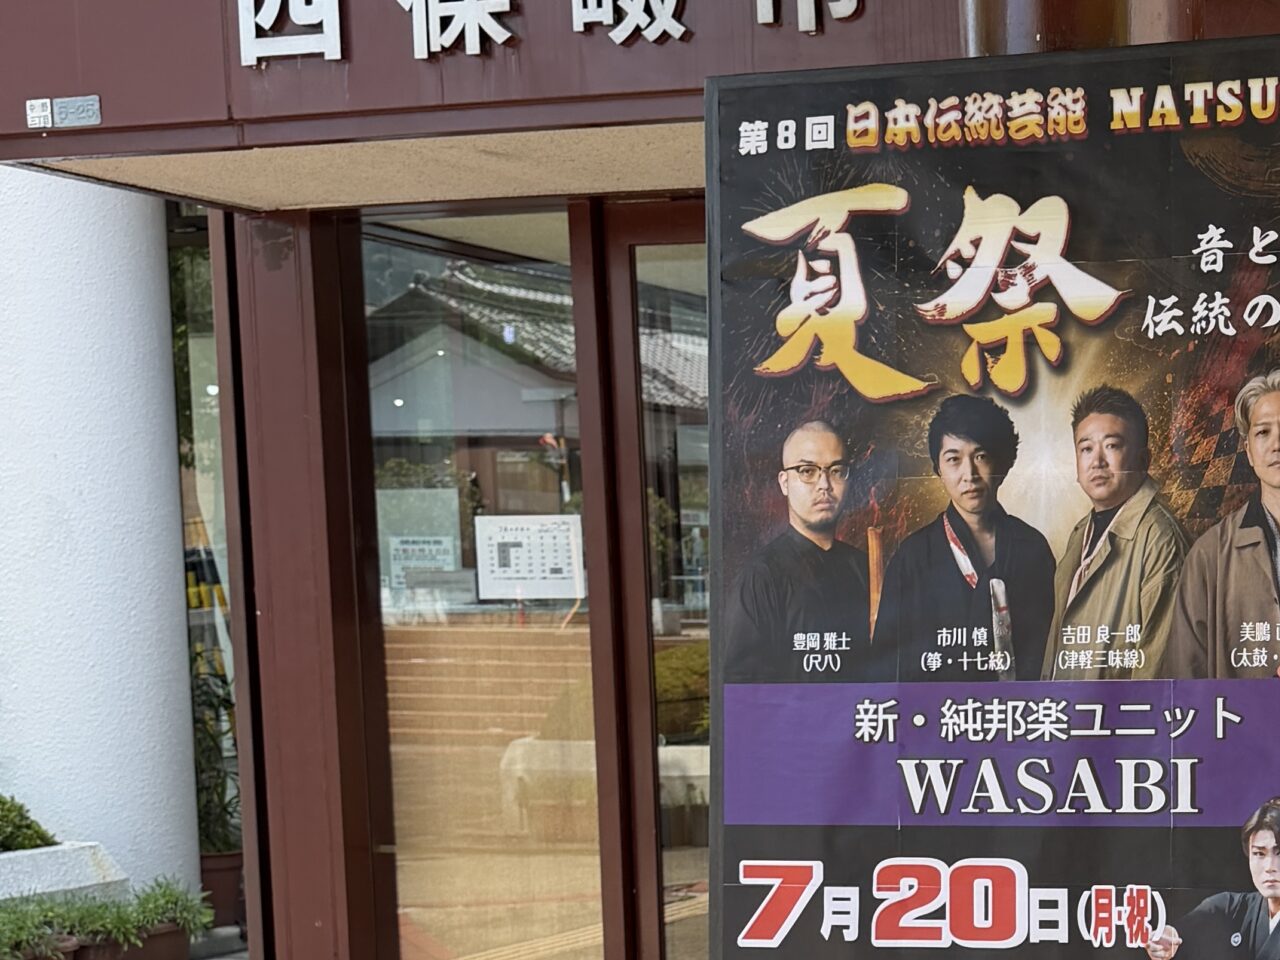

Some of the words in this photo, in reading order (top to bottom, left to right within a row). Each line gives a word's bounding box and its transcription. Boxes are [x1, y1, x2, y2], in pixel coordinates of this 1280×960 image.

[738, 115, 835, 157] 第8回
[845, 87, 1089, 153] 日本伝統芸能
[1061, 624, 1091, 645] 吉田
[1095, 623, 1142, 644] 良一郎
[803, 653, 841, 672] (尺八)
[1057, 646, 1146, 670] (津軽三味線)
[854, 695, 1244, 743] 新・純邦楽ユニット
[898, 757, 1202, 814] WASABI
